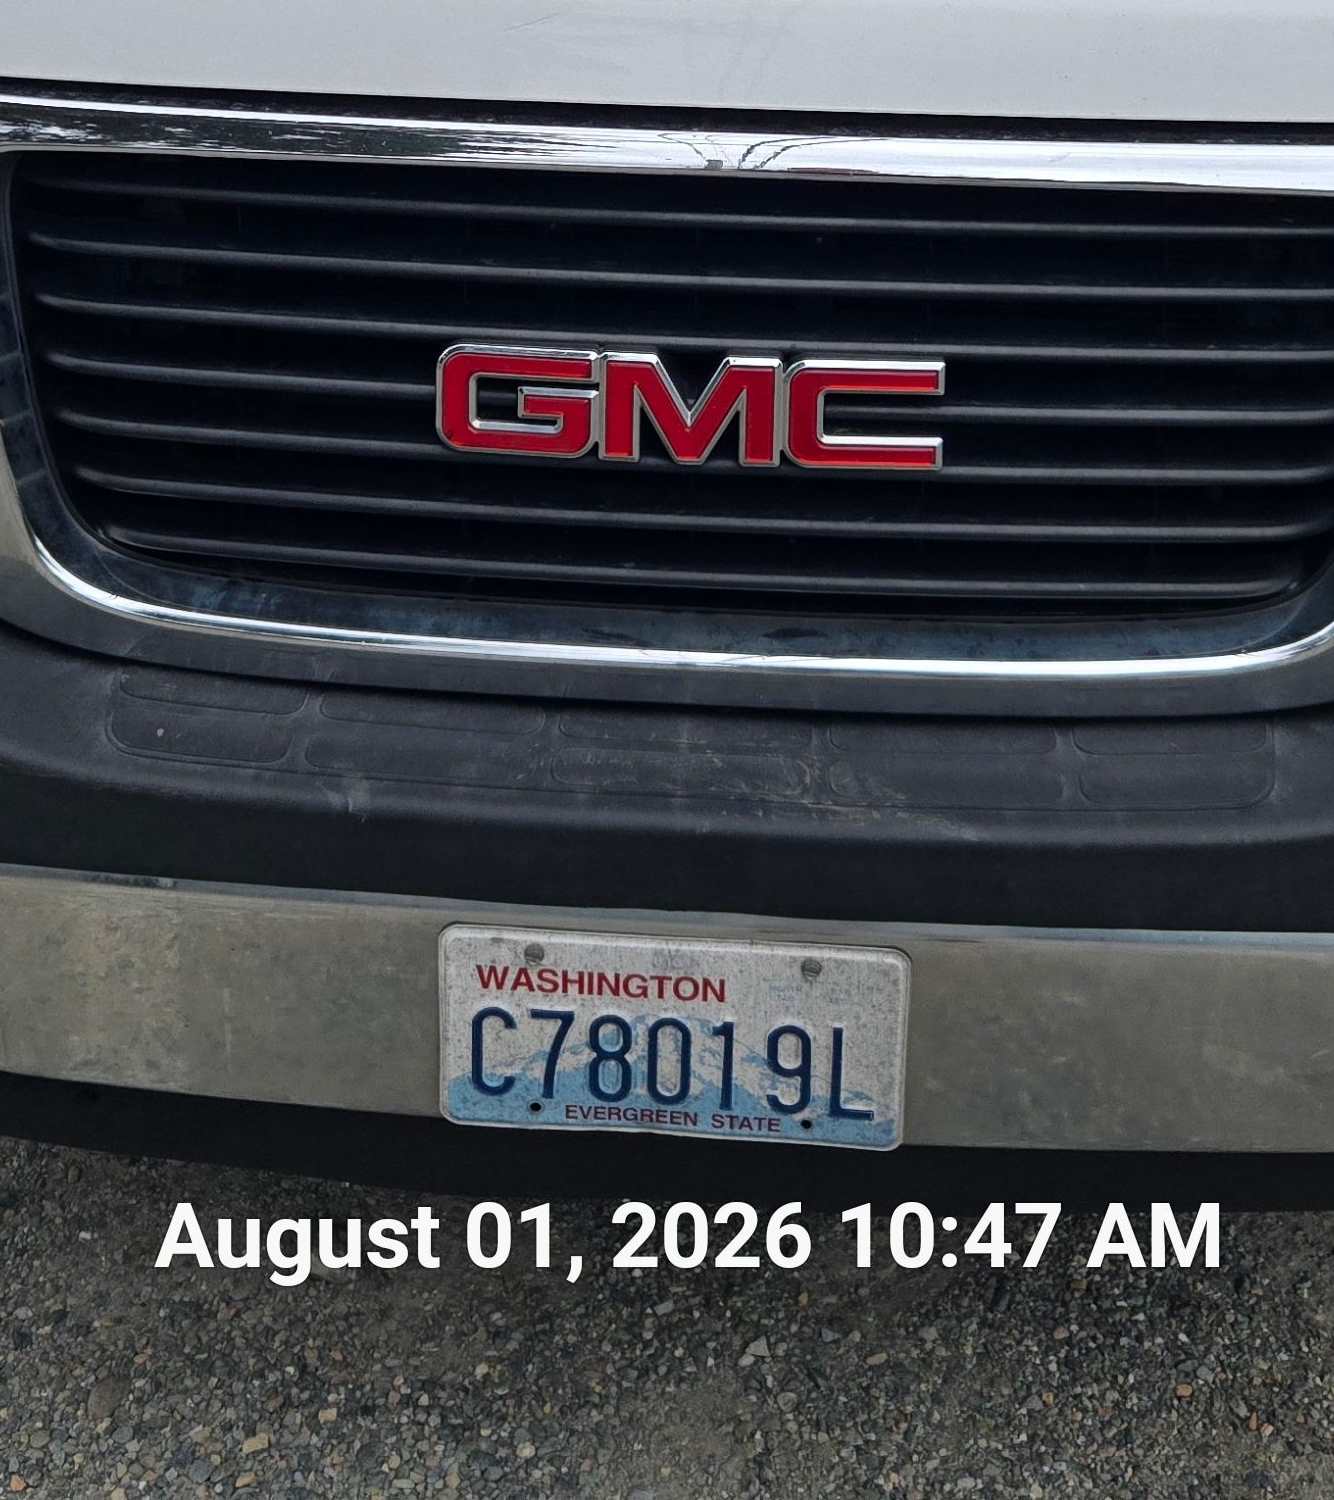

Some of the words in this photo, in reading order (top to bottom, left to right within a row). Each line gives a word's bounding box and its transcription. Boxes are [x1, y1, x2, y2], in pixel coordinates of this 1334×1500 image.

[435, 344, 946, 470] GMC
[476, 964, 726, 1003] WASHINGTON
[471, 1006, 875, 1121] C78019L
[565, 1104, 699, 1128] EVERGREEN
[711, 1112, 781, 1133] STATE
